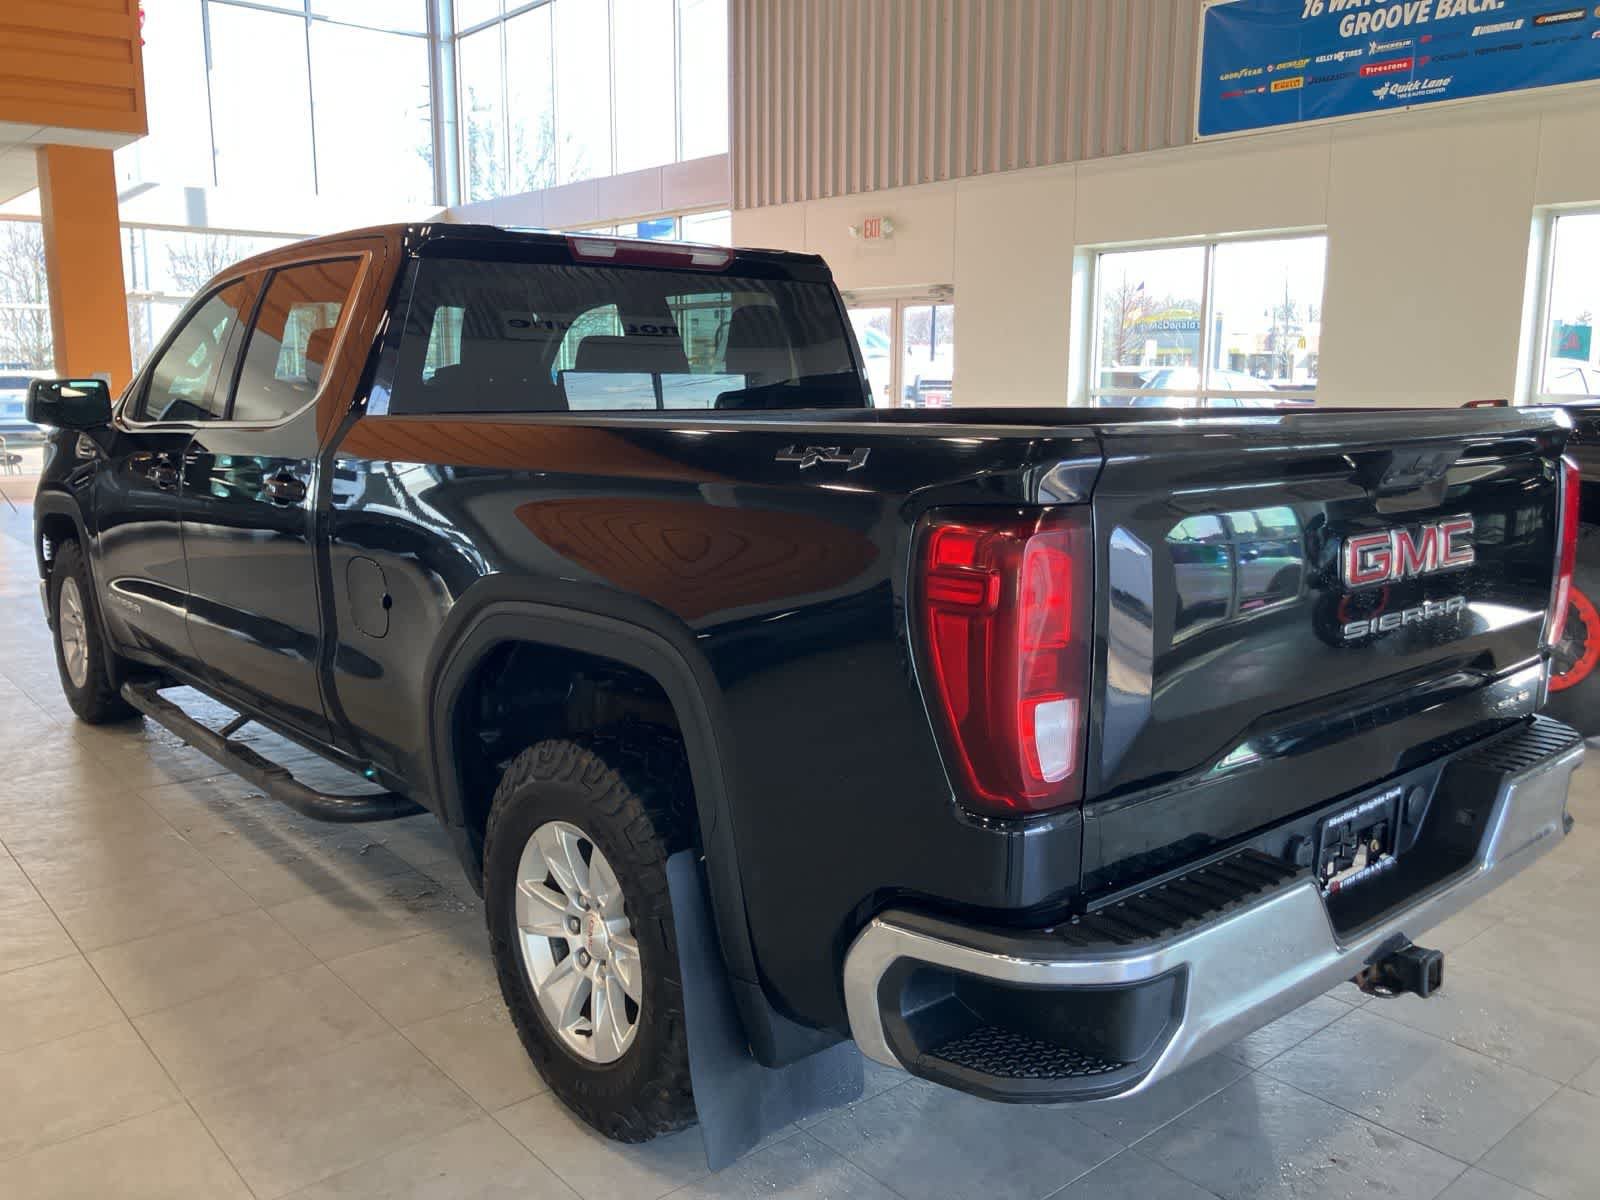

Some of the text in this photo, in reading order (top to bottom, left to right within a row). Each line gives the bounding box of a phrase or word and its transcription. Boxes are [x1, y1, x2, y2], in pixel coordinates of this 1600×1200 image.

[1339, 0, 1431, 38] GROOVE
[1365, 61, 1408, 76] Firestone
[1389, 77, 1451, 96] Quick Lane
[864, 218, 881, 240] EXIT
[1343, 513, 1475, 590] GMC
[1343, 596, 1466, 640] SIERRA
